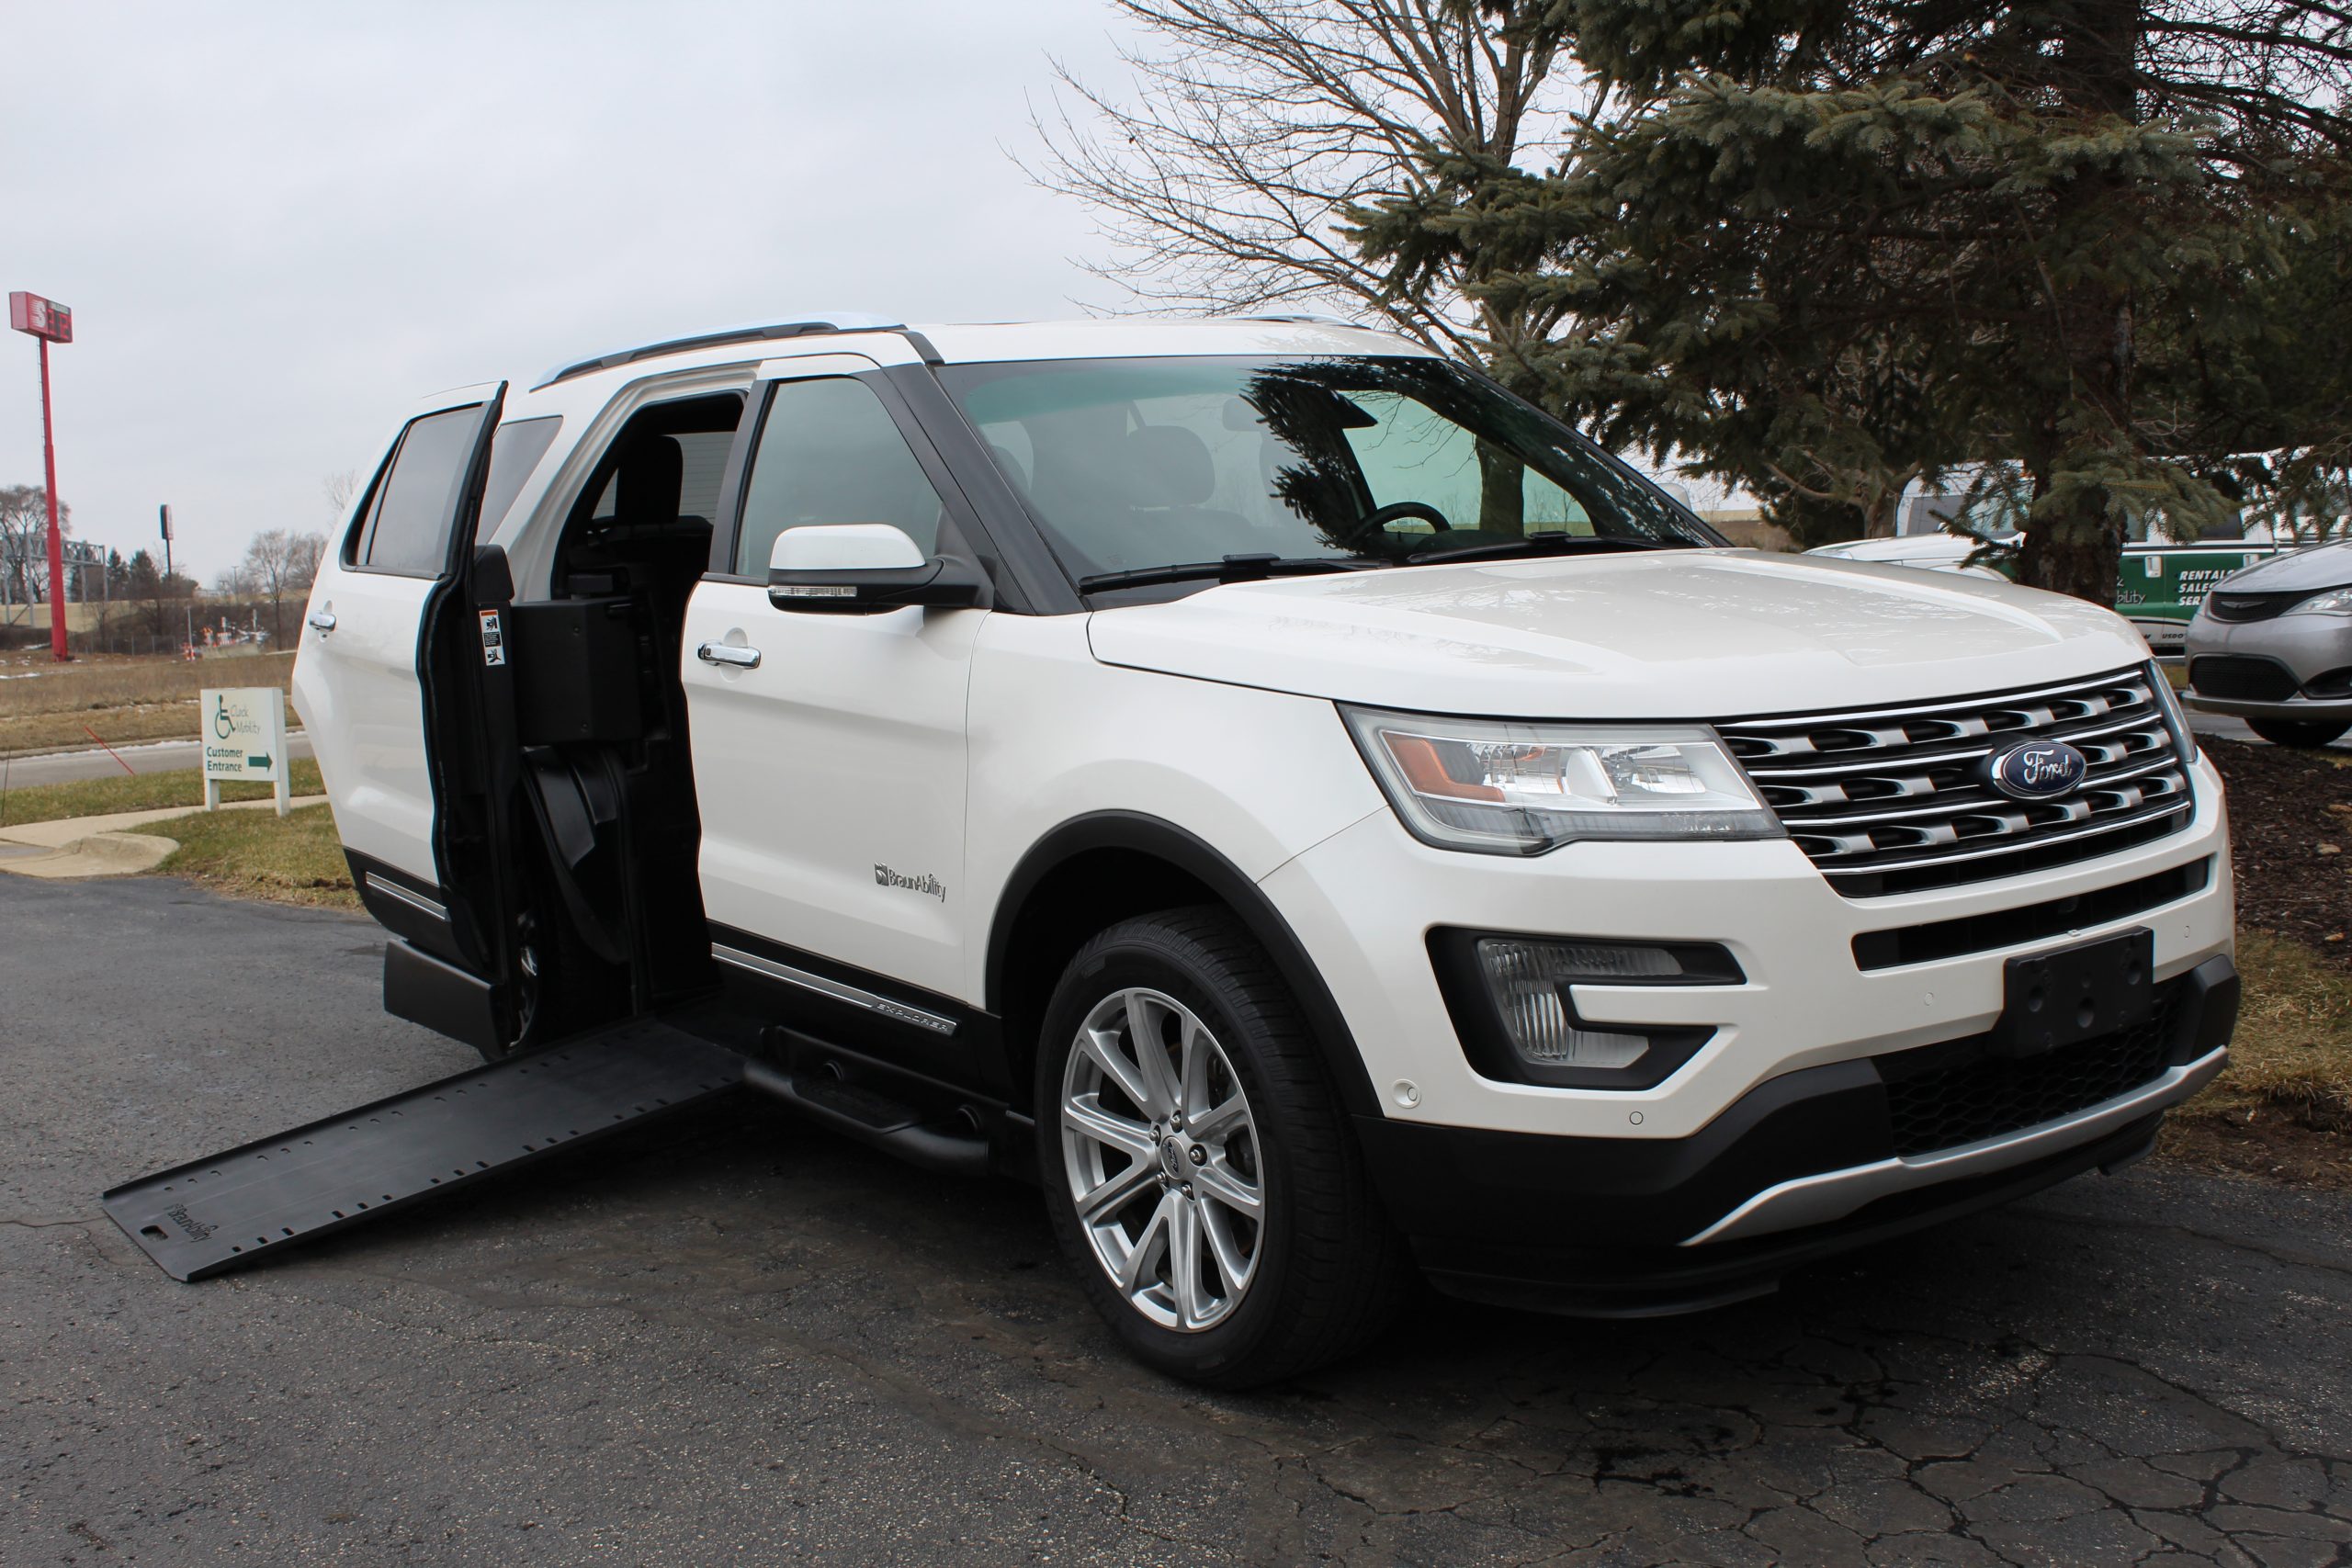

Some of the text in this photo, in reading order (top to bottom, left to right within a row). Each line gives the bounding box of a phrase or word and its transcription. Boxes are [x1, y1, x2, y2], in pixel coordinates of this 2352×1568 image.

[207, 746, 243, 758] Customer
[207, 761, 243, 773] Entrance
[2024, 749, 2073, 784] Ford
[888, 867, 946, 903] BraunAbility
[876, 1002, 948, 1032] EXPLORER
